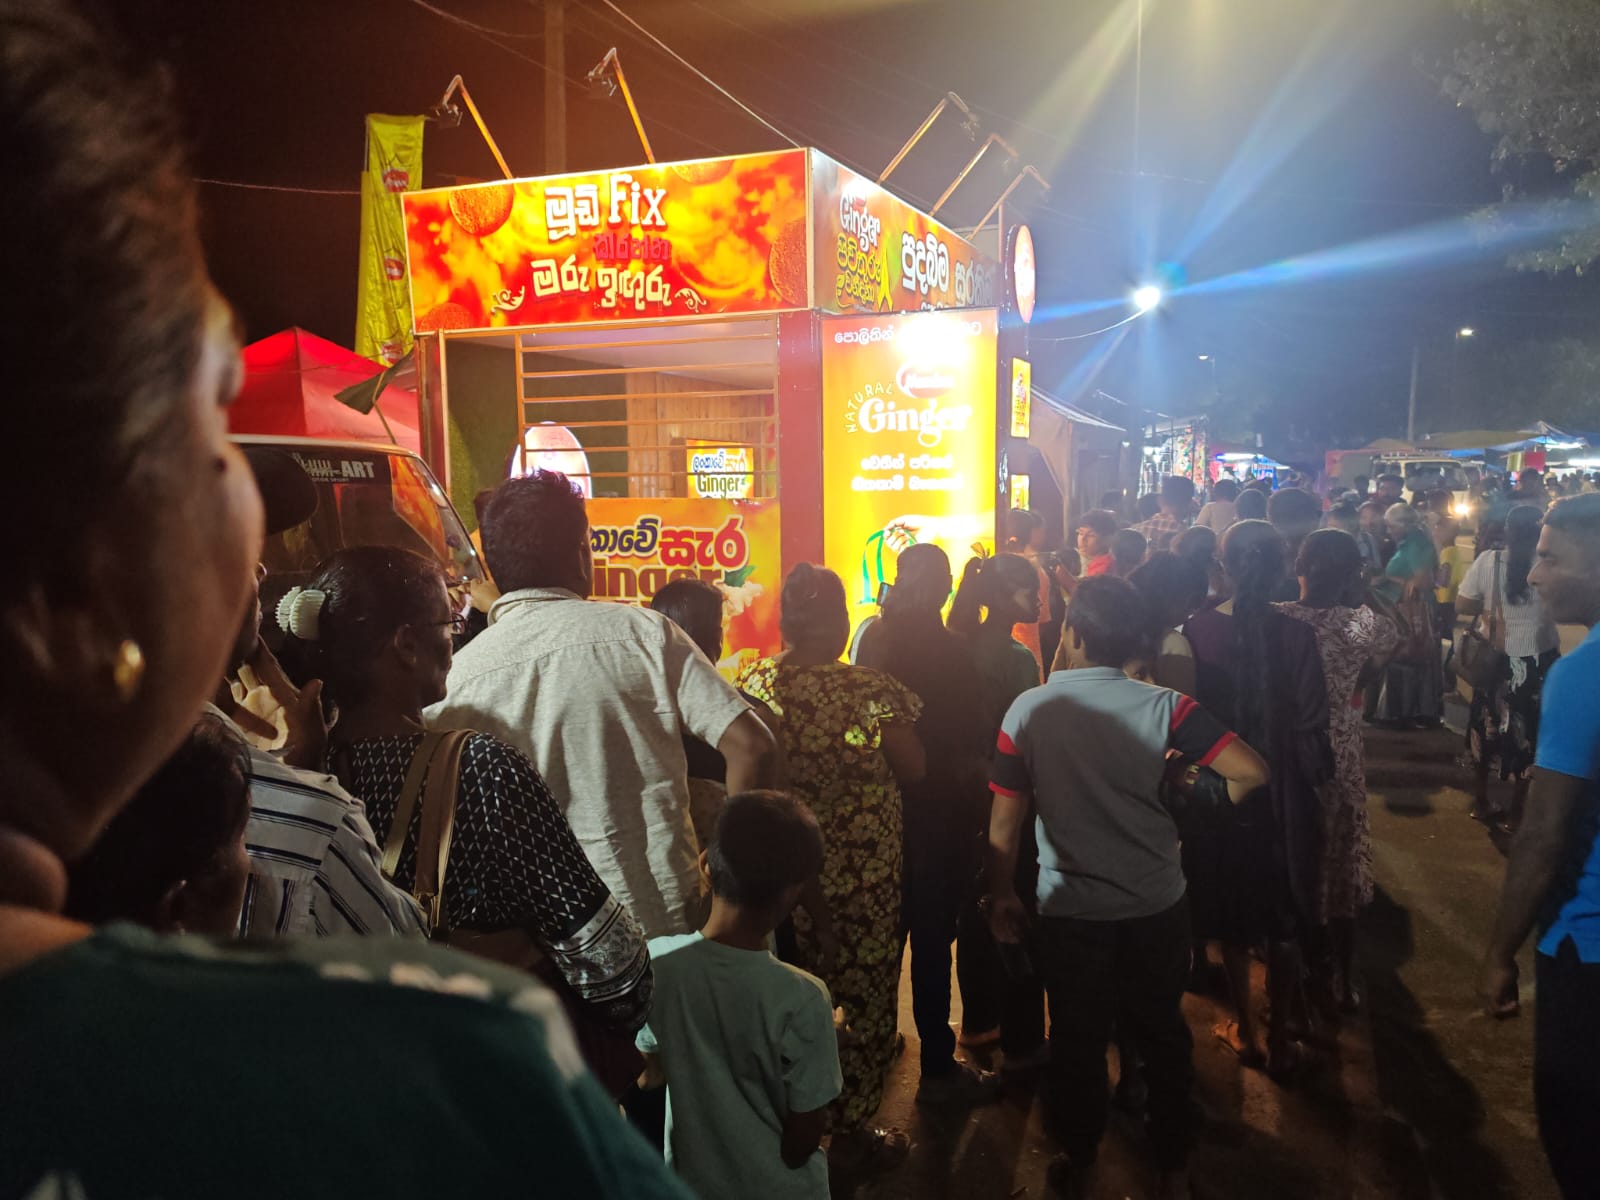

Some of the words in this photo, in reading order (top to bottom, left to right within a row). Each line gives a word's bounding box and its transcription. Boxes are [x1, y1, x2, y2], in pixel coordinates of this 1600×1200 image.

[608, 174, 666, 227] Fix
[839, 191, 881, 252] Ginger
[531, 254, 590, 297] මරු
[845, 382, 894, 434] NATURAL
[858, 397, 972, 448] Ginger
[697, 471, 741, 498] Ginger
[659, 517, 746, 568] සැර
